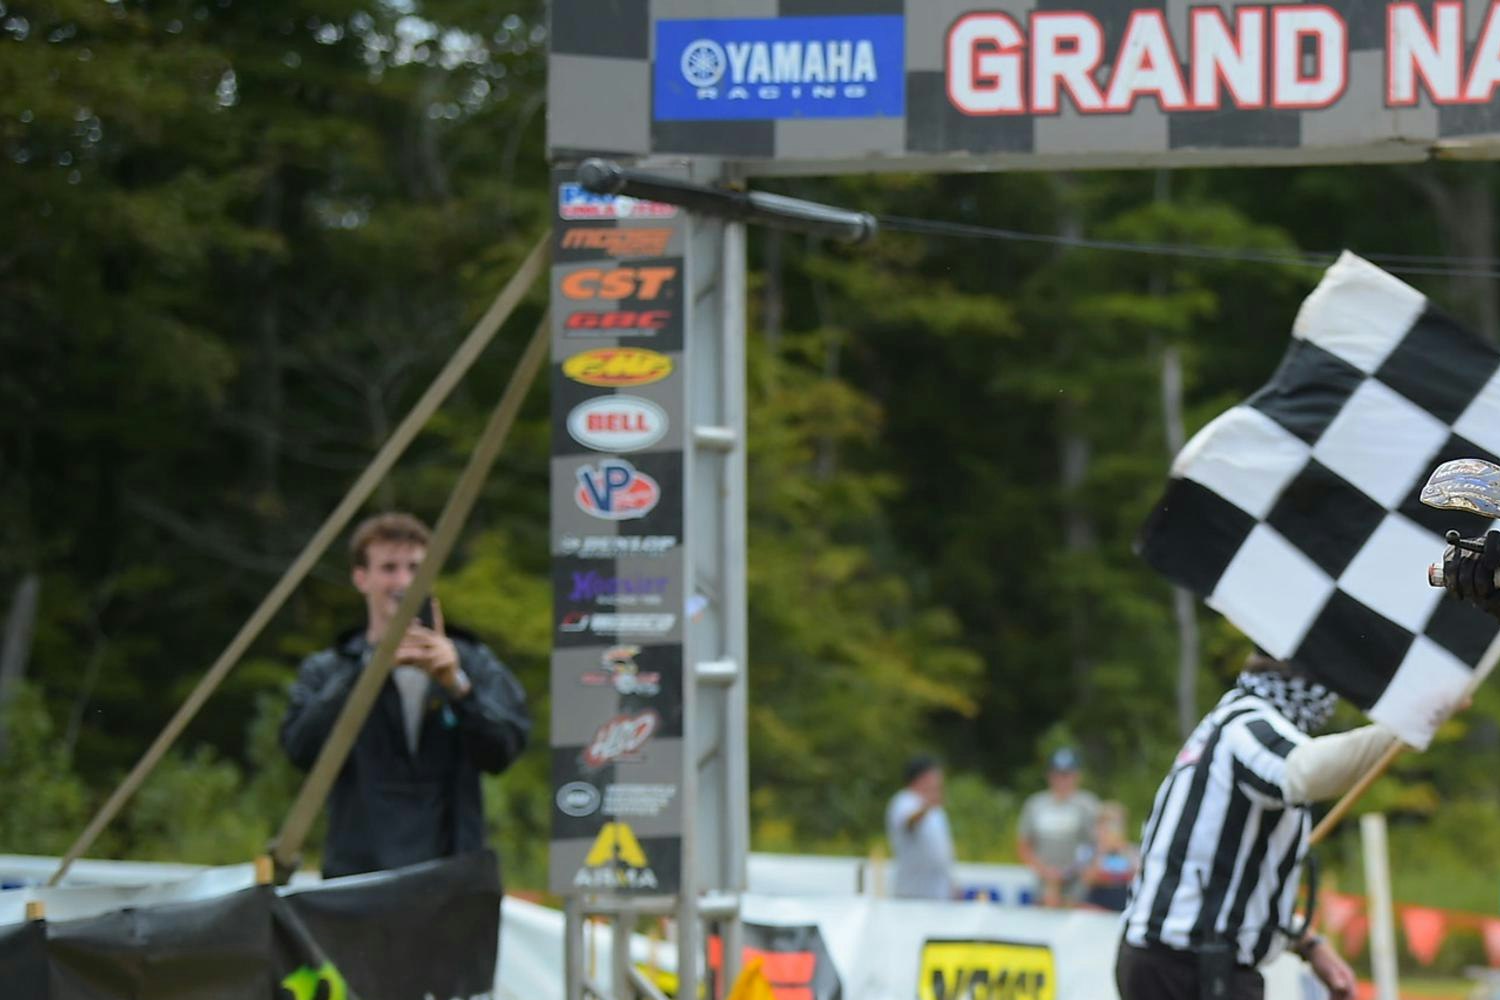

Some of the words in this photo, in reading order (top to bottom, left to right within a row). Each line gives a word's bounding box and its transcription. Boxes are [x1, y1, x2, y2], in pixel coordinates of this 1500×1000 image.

[725, 39, 877, 85] YAMAHA
[945, 6, 1349, 116] GRAND
[696, 85, 867, 100] RACING
[561, 267, 677, 301] CST
[586, 412, 650, 433] BELL
[583, 465, 632, 512] VP
